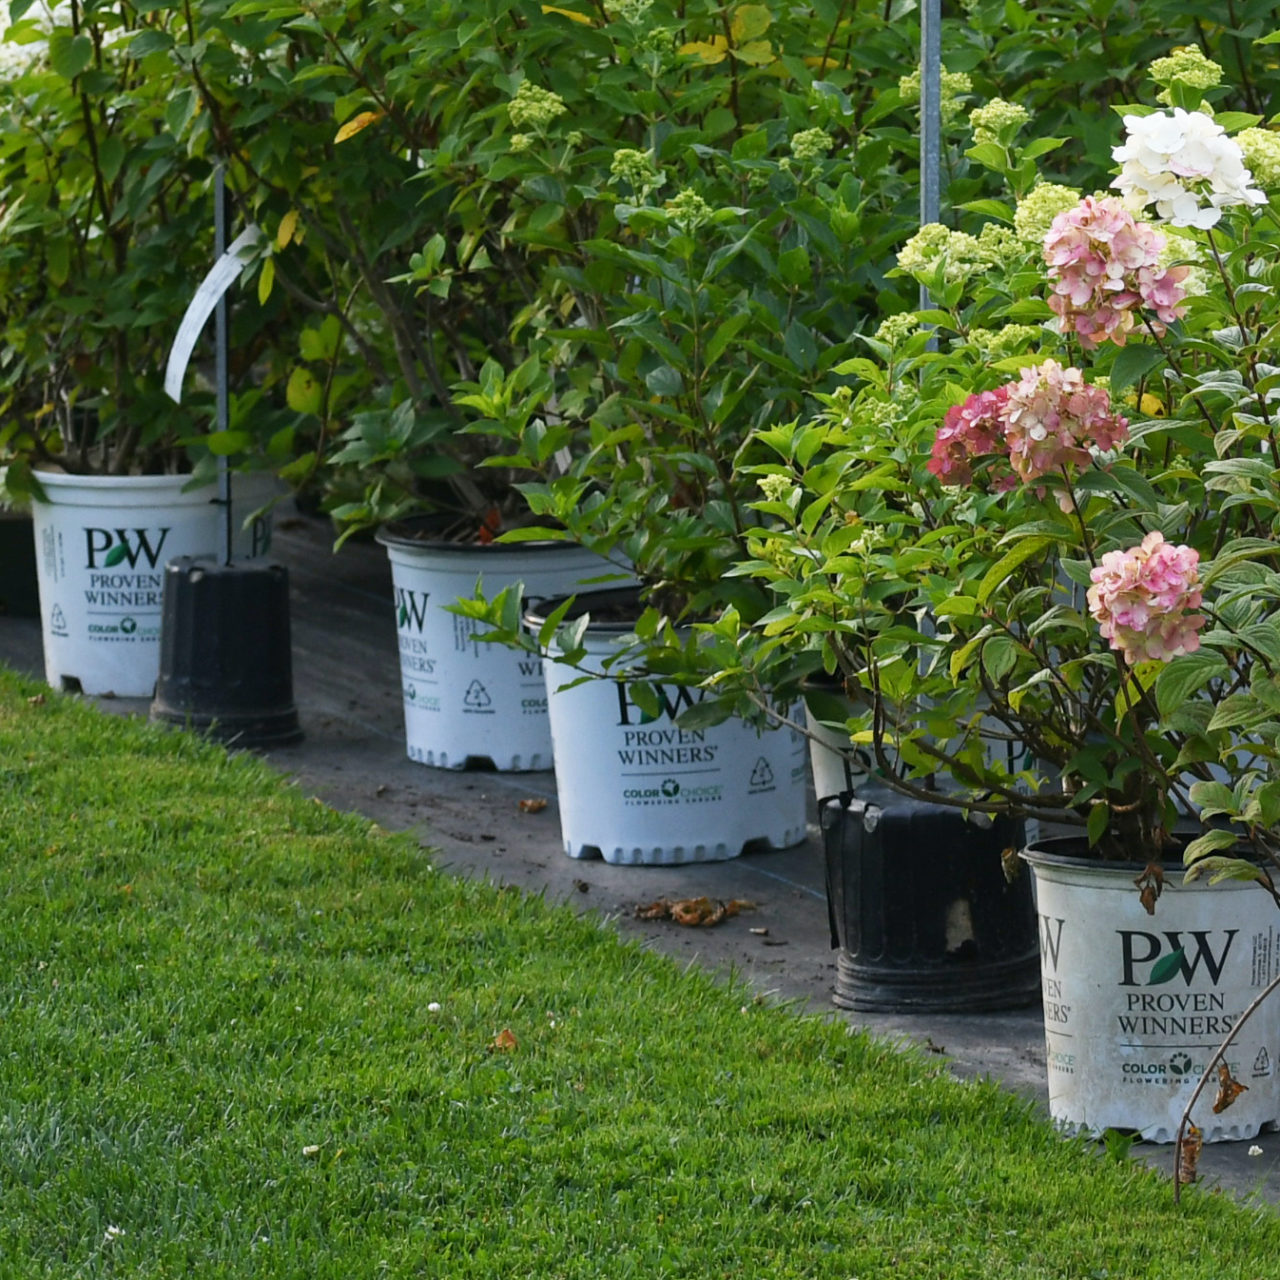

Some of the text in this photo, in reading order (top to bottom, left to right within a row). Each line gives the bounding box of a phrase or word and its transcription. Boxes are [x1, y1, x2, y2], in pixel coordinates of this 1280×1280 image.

[83, 527, 171, 570] PW
[90, 574, 162, 589] PROVEN
[624, 729, 705, 747] PROVEN
[623, 788, 659, 799] COLOR
[1115, 929, 1240, 987] PW
[1126, 993, 1226, 1013] PROVEN
[1122, 1063, 1167, 1075] COLOR
